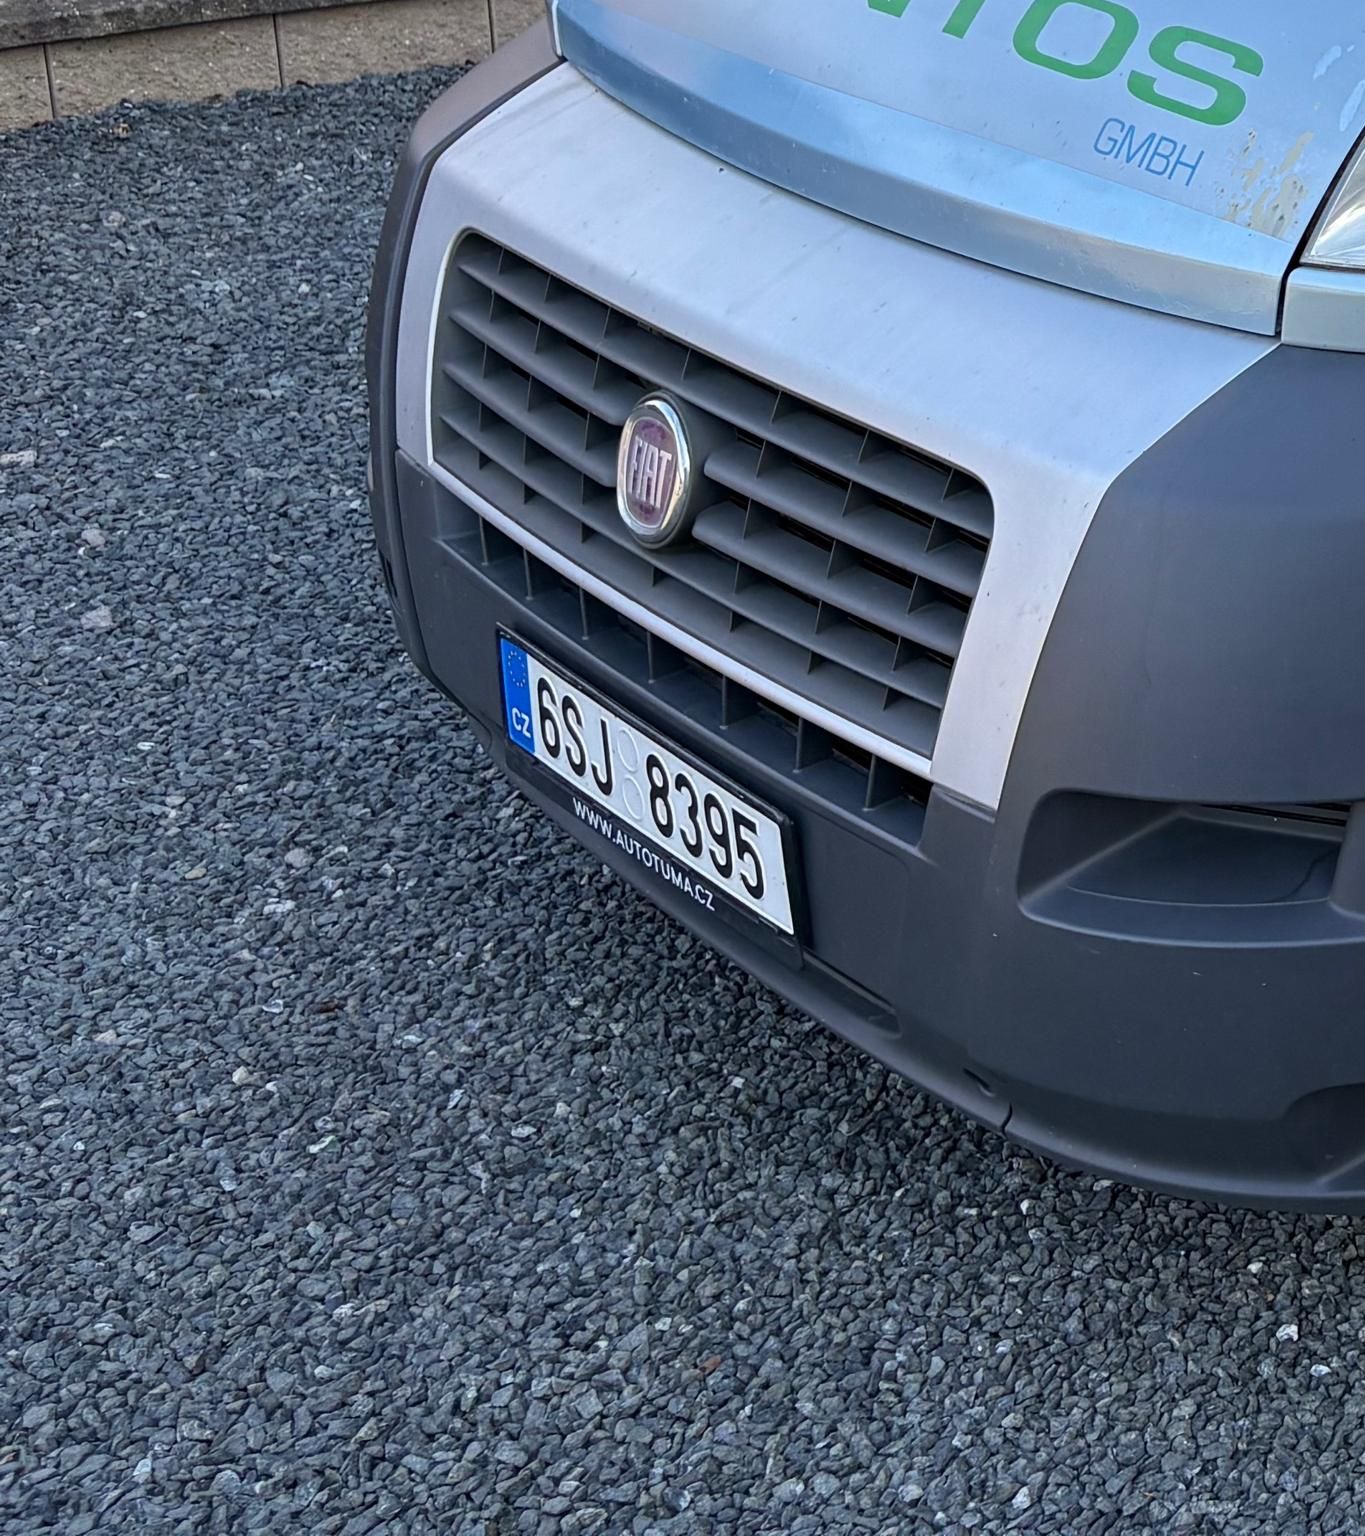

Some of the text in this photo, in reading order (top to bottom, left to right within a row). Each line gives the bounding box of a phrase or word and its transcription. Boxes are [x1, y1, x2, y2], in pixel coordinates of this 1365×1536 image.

[1094, 117, 1205, 187] GMBH
[629, 435, 673, 510] FIAT
[511, 707, 531, 739] CZ
[537, 677, 765, 900] 6SJ 8395
[572, 797, 715, 911] WWW.AUTOTUMA.CZ
